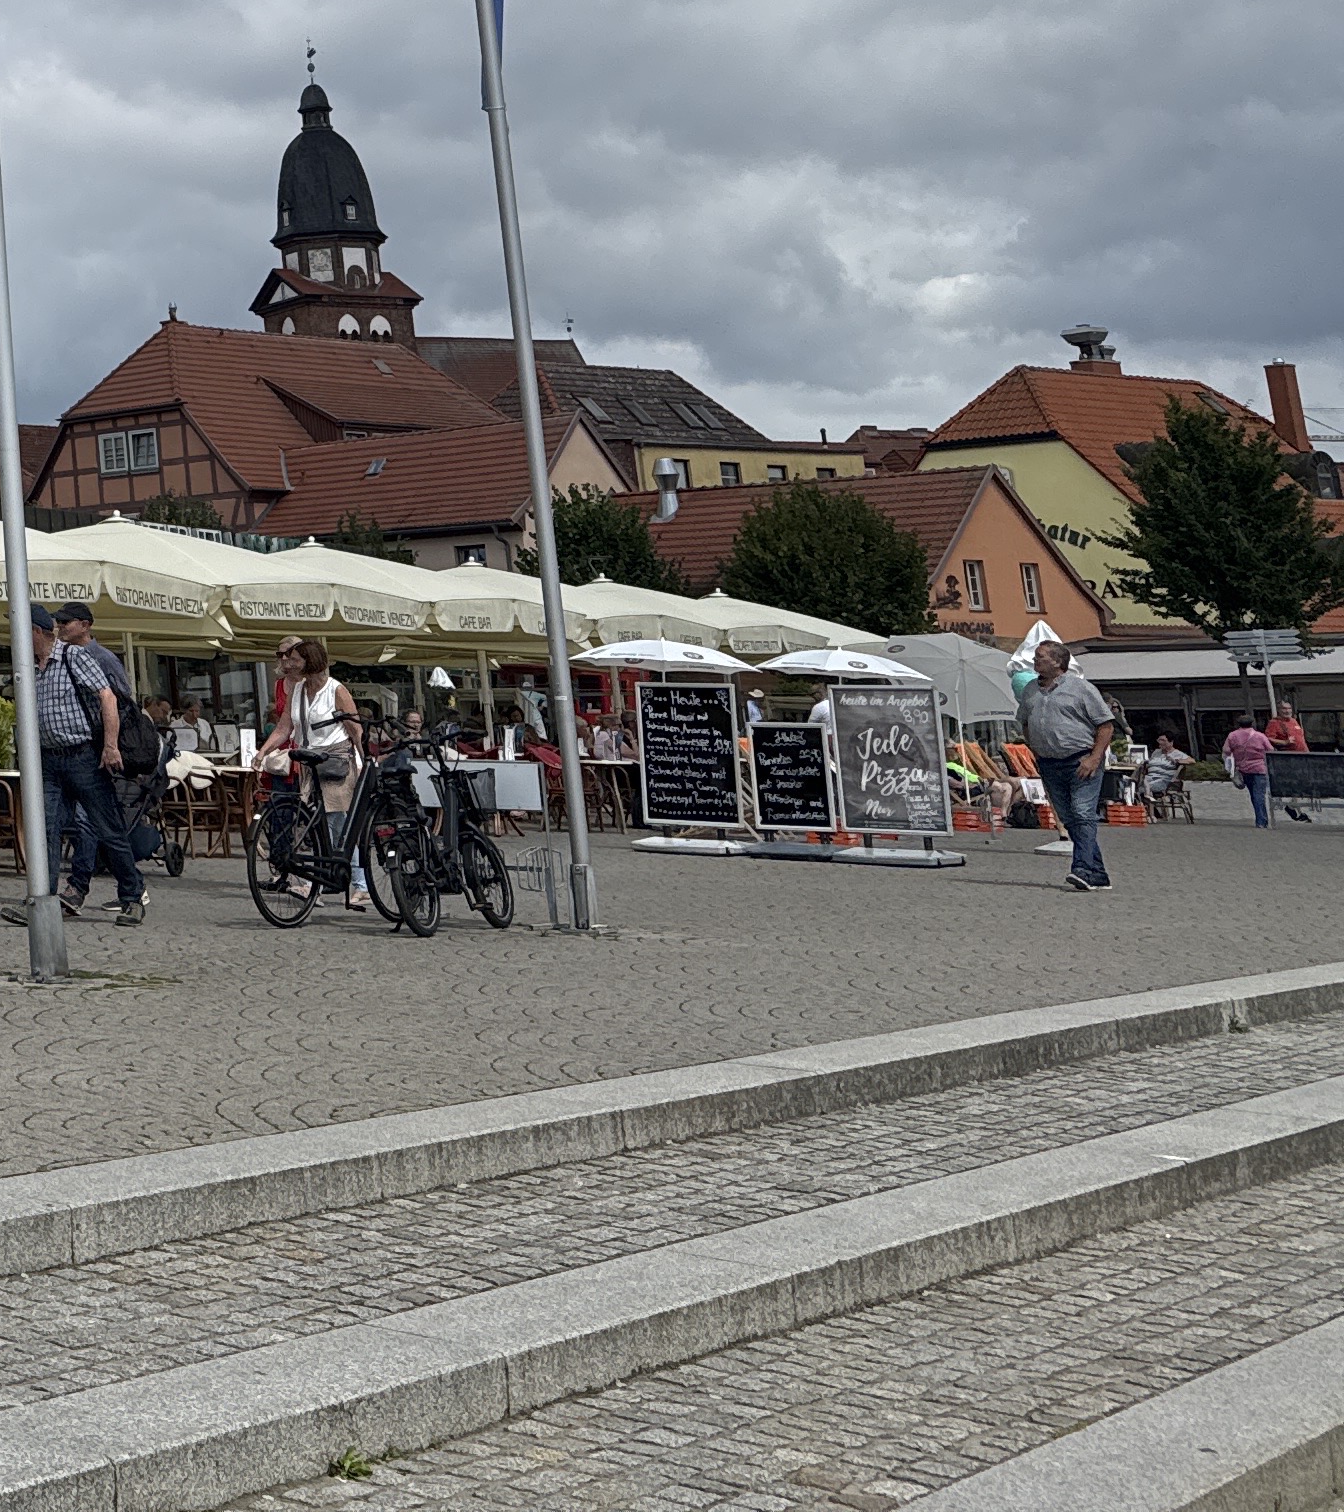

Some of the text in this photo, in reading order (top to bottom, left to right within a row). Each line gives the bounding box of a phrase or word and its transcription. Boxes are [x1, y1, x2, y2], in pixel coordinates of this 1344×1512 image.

[52, 582, 95, 600] VENEZIA
[115, 586, 205, 616] RISTORANTE VENEZIA
[239, 601, 327, 619] RISTORANTE VENEZIA
[343, 605, 386, 625] RISTORANTE
[459, 615, 492, 630] CAFE BAR
[670, 690, 703, 707] Heute
[840, 693, 868, 706] heute
[886, 694, 930, 712] Angebot
[856, 724, 914, 760] Jede
[860, 759, 928, 797] Pizza
